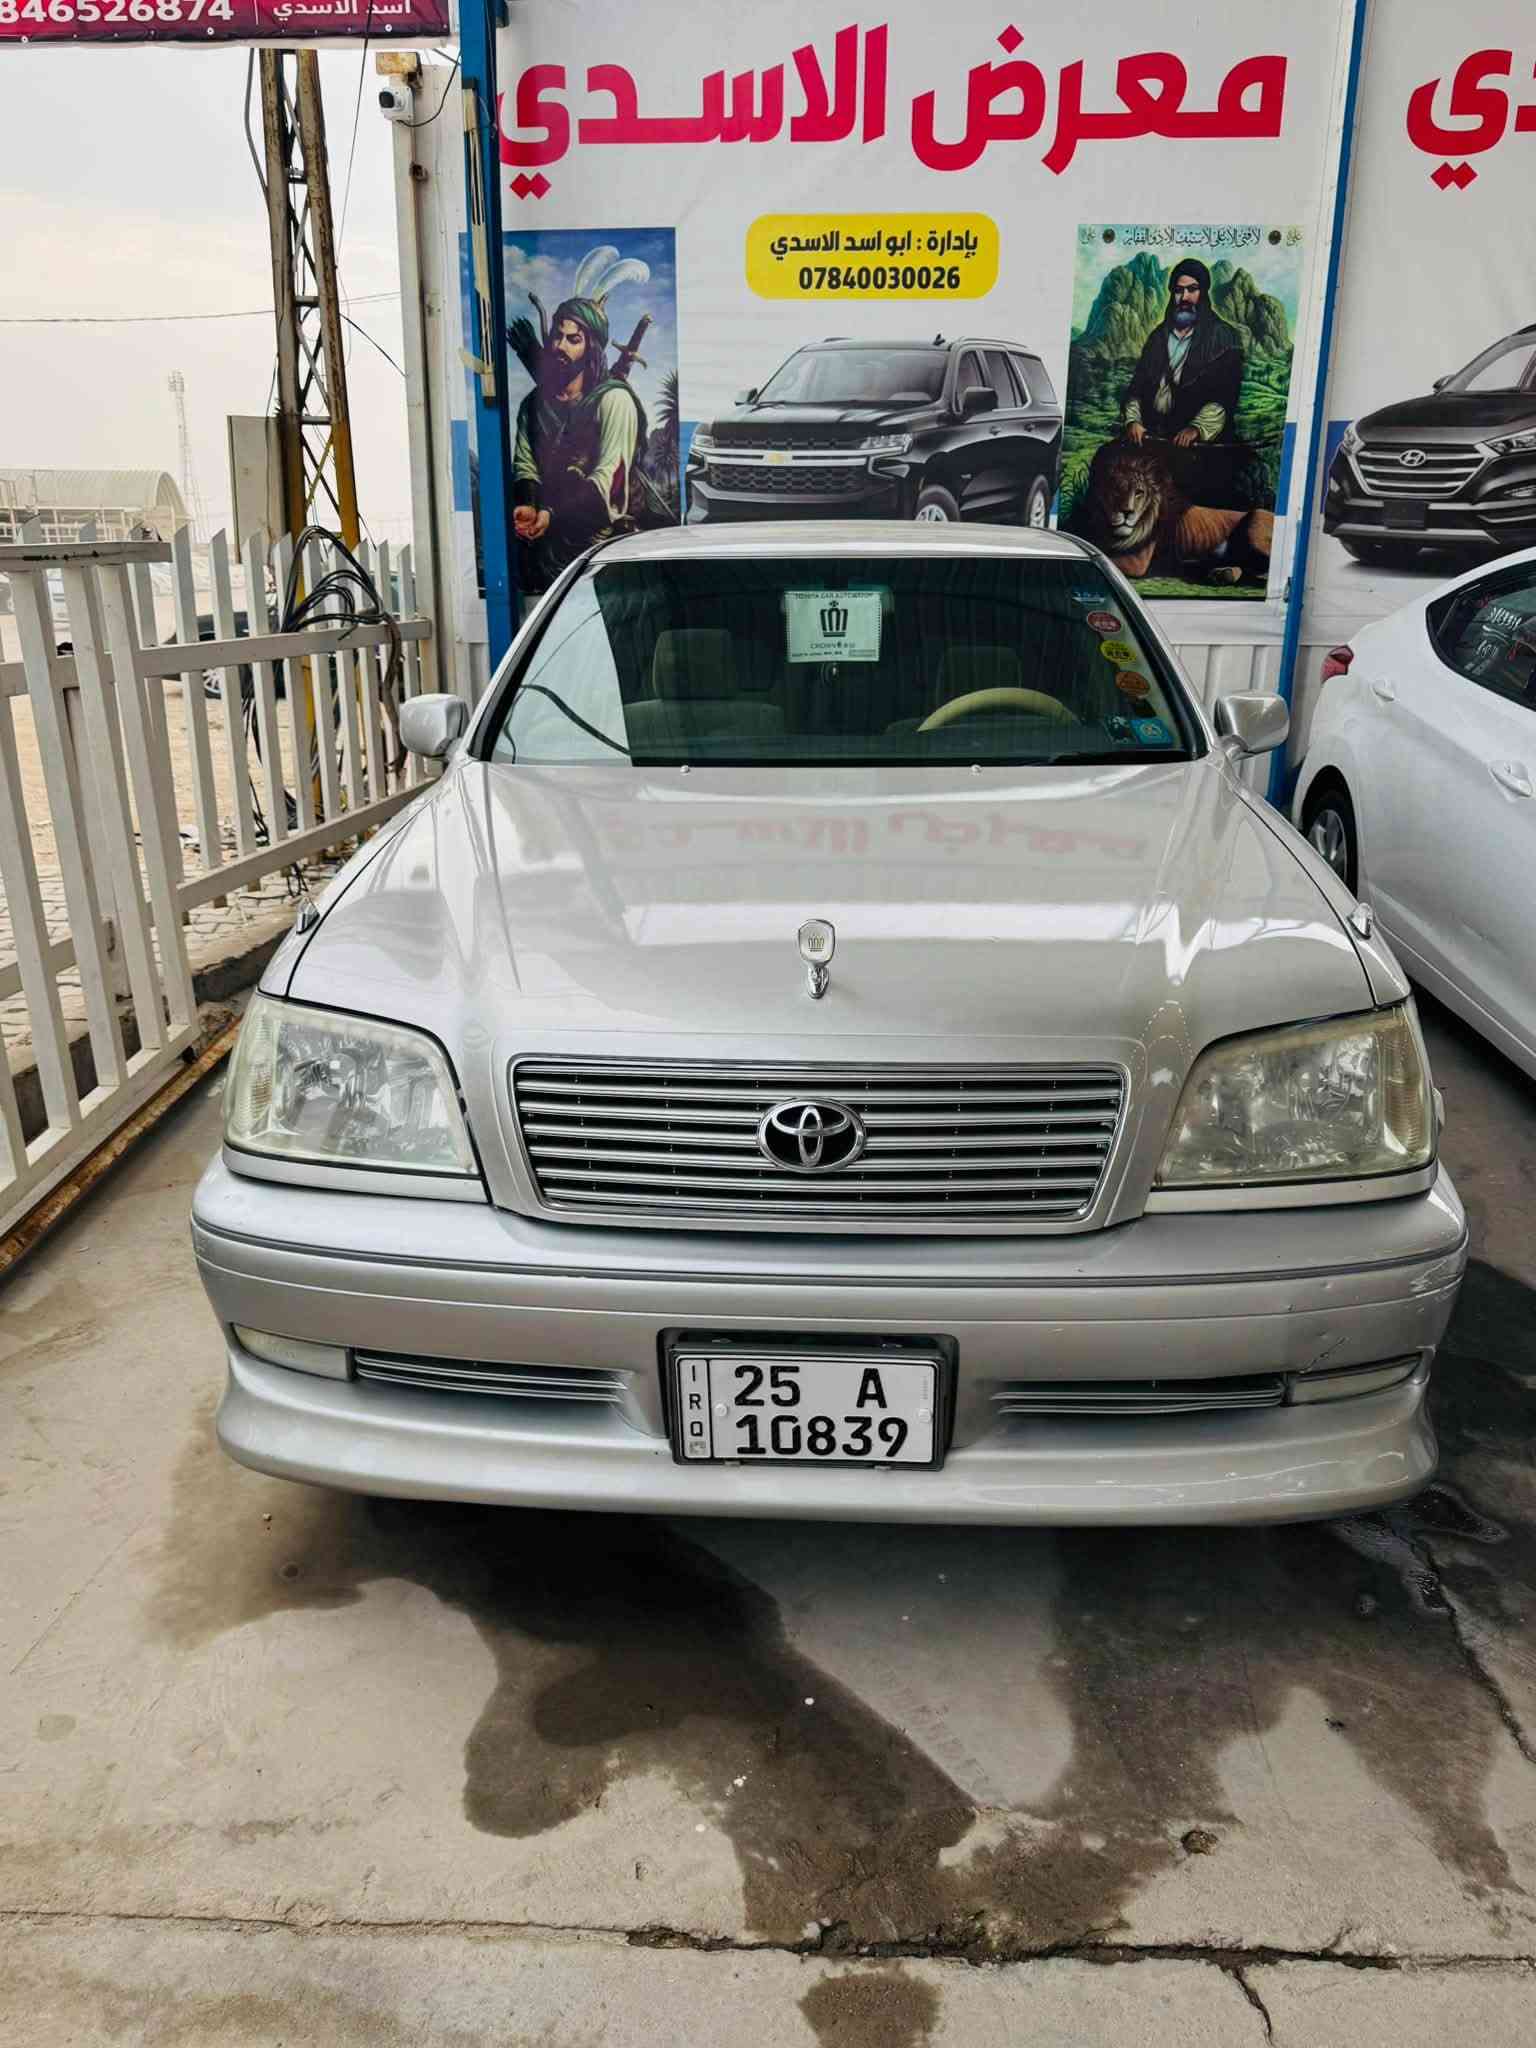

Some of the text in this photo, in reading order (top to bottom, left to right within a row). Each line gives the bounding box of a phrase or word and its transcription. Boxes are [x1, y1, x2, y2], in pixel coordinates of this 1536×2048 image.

[499, 24, 1287, 199] معرض الاسدي
[770, 230, 840, 260] الاسدي
[844, 230, 882, 252] اسد
[886, 230, 912, 257] ابو
[926, 230, 978, 258] بإدارة
[799, 266, 960, 289] 07840030026
[734, 1364, 801, 1408] 25
[856, 1367, 888, 1409] A
[735, 1414, 909, 1458] 10839
